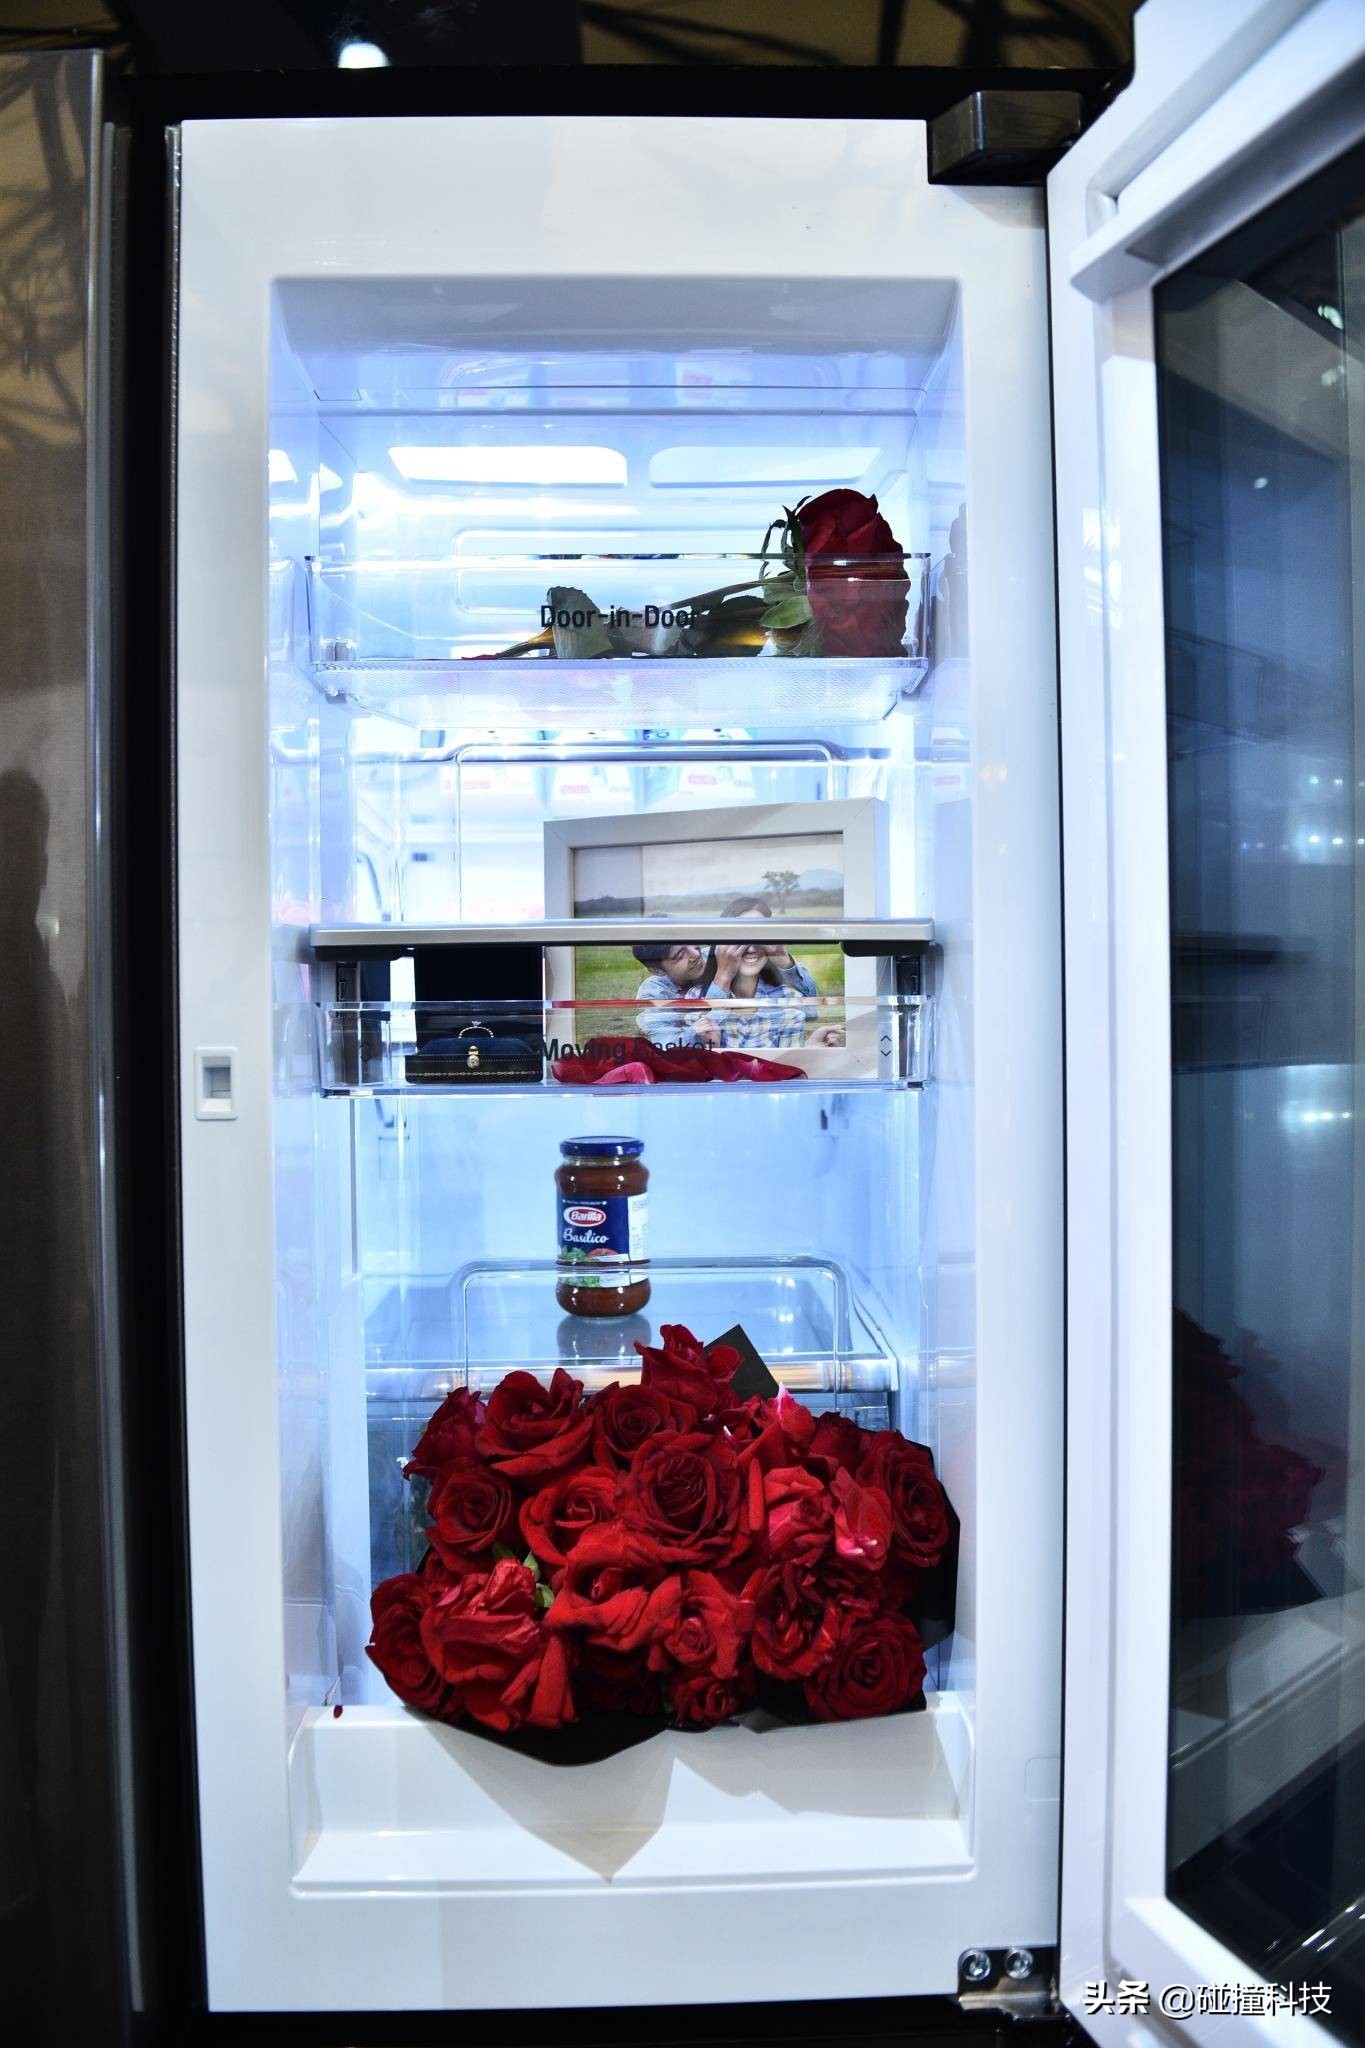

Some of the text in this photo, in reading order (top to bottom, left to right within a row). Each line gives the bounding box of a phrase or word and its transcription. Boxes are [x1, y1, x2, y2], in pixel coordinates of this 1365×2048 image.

[541, 1038, 626, 1065] Moving
[571, 1210, 603, 1221] Barilla
[563, 1228, 609, 1244] Basilico
